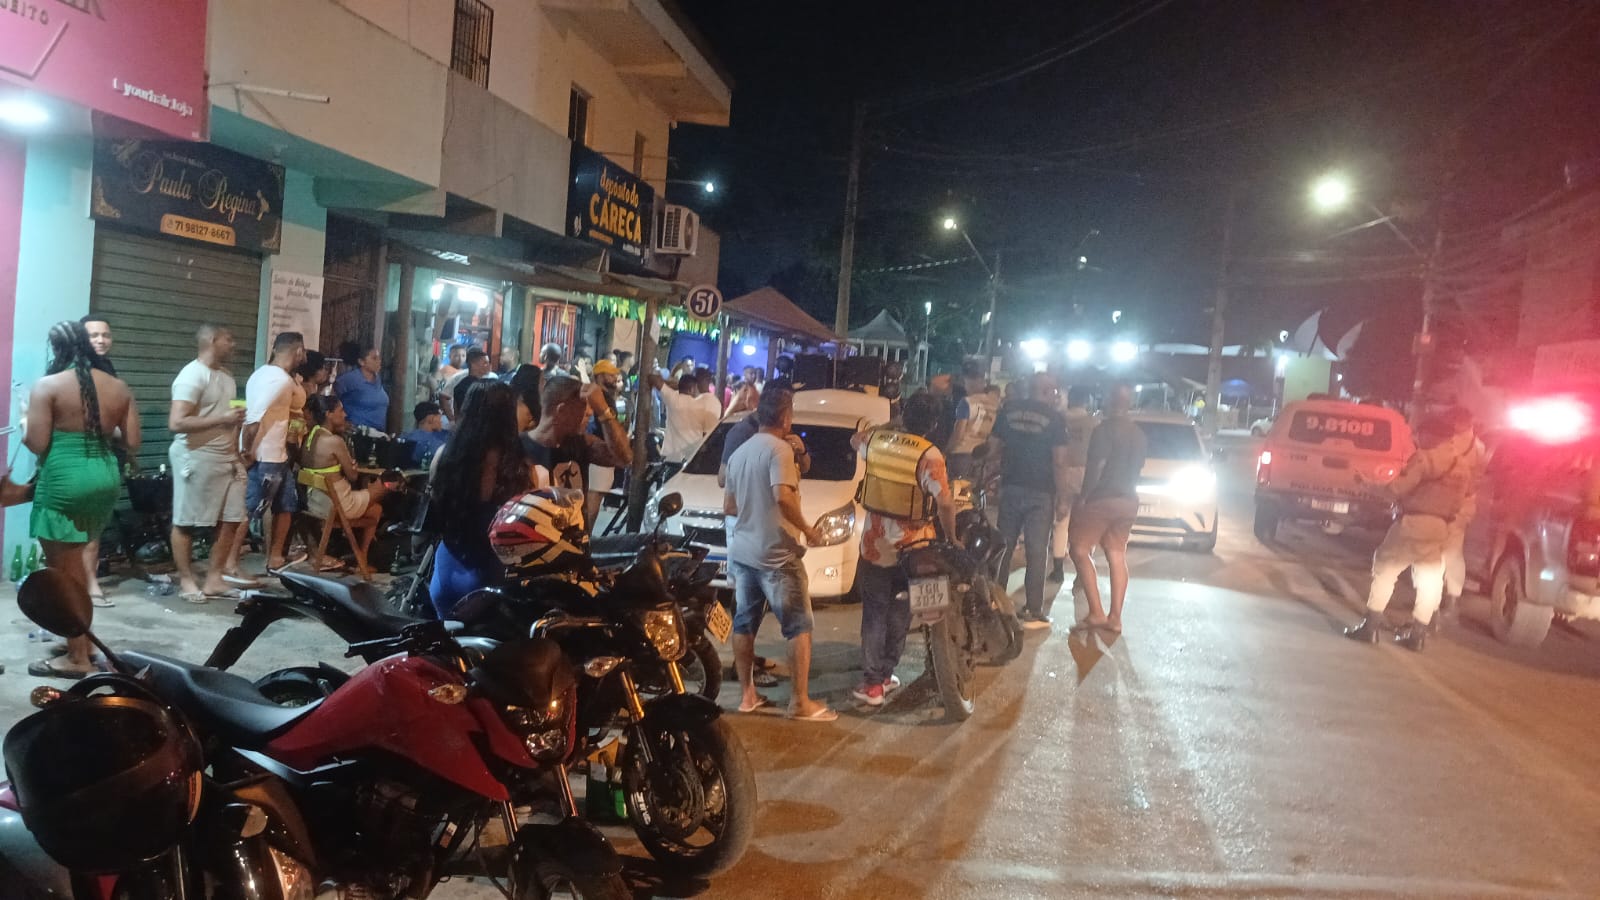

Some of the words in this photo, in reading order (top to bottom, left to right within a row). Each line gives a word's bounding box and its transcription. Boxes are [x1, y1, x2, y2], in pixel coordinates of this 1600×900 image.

[133, 151, 193, 200] Paula
[199, 169, 258, 224] Regina
[175, 220, 184, 231] 71
[589, 192, 641, 244] CARECA
[694, 291, 714, 314] 51
